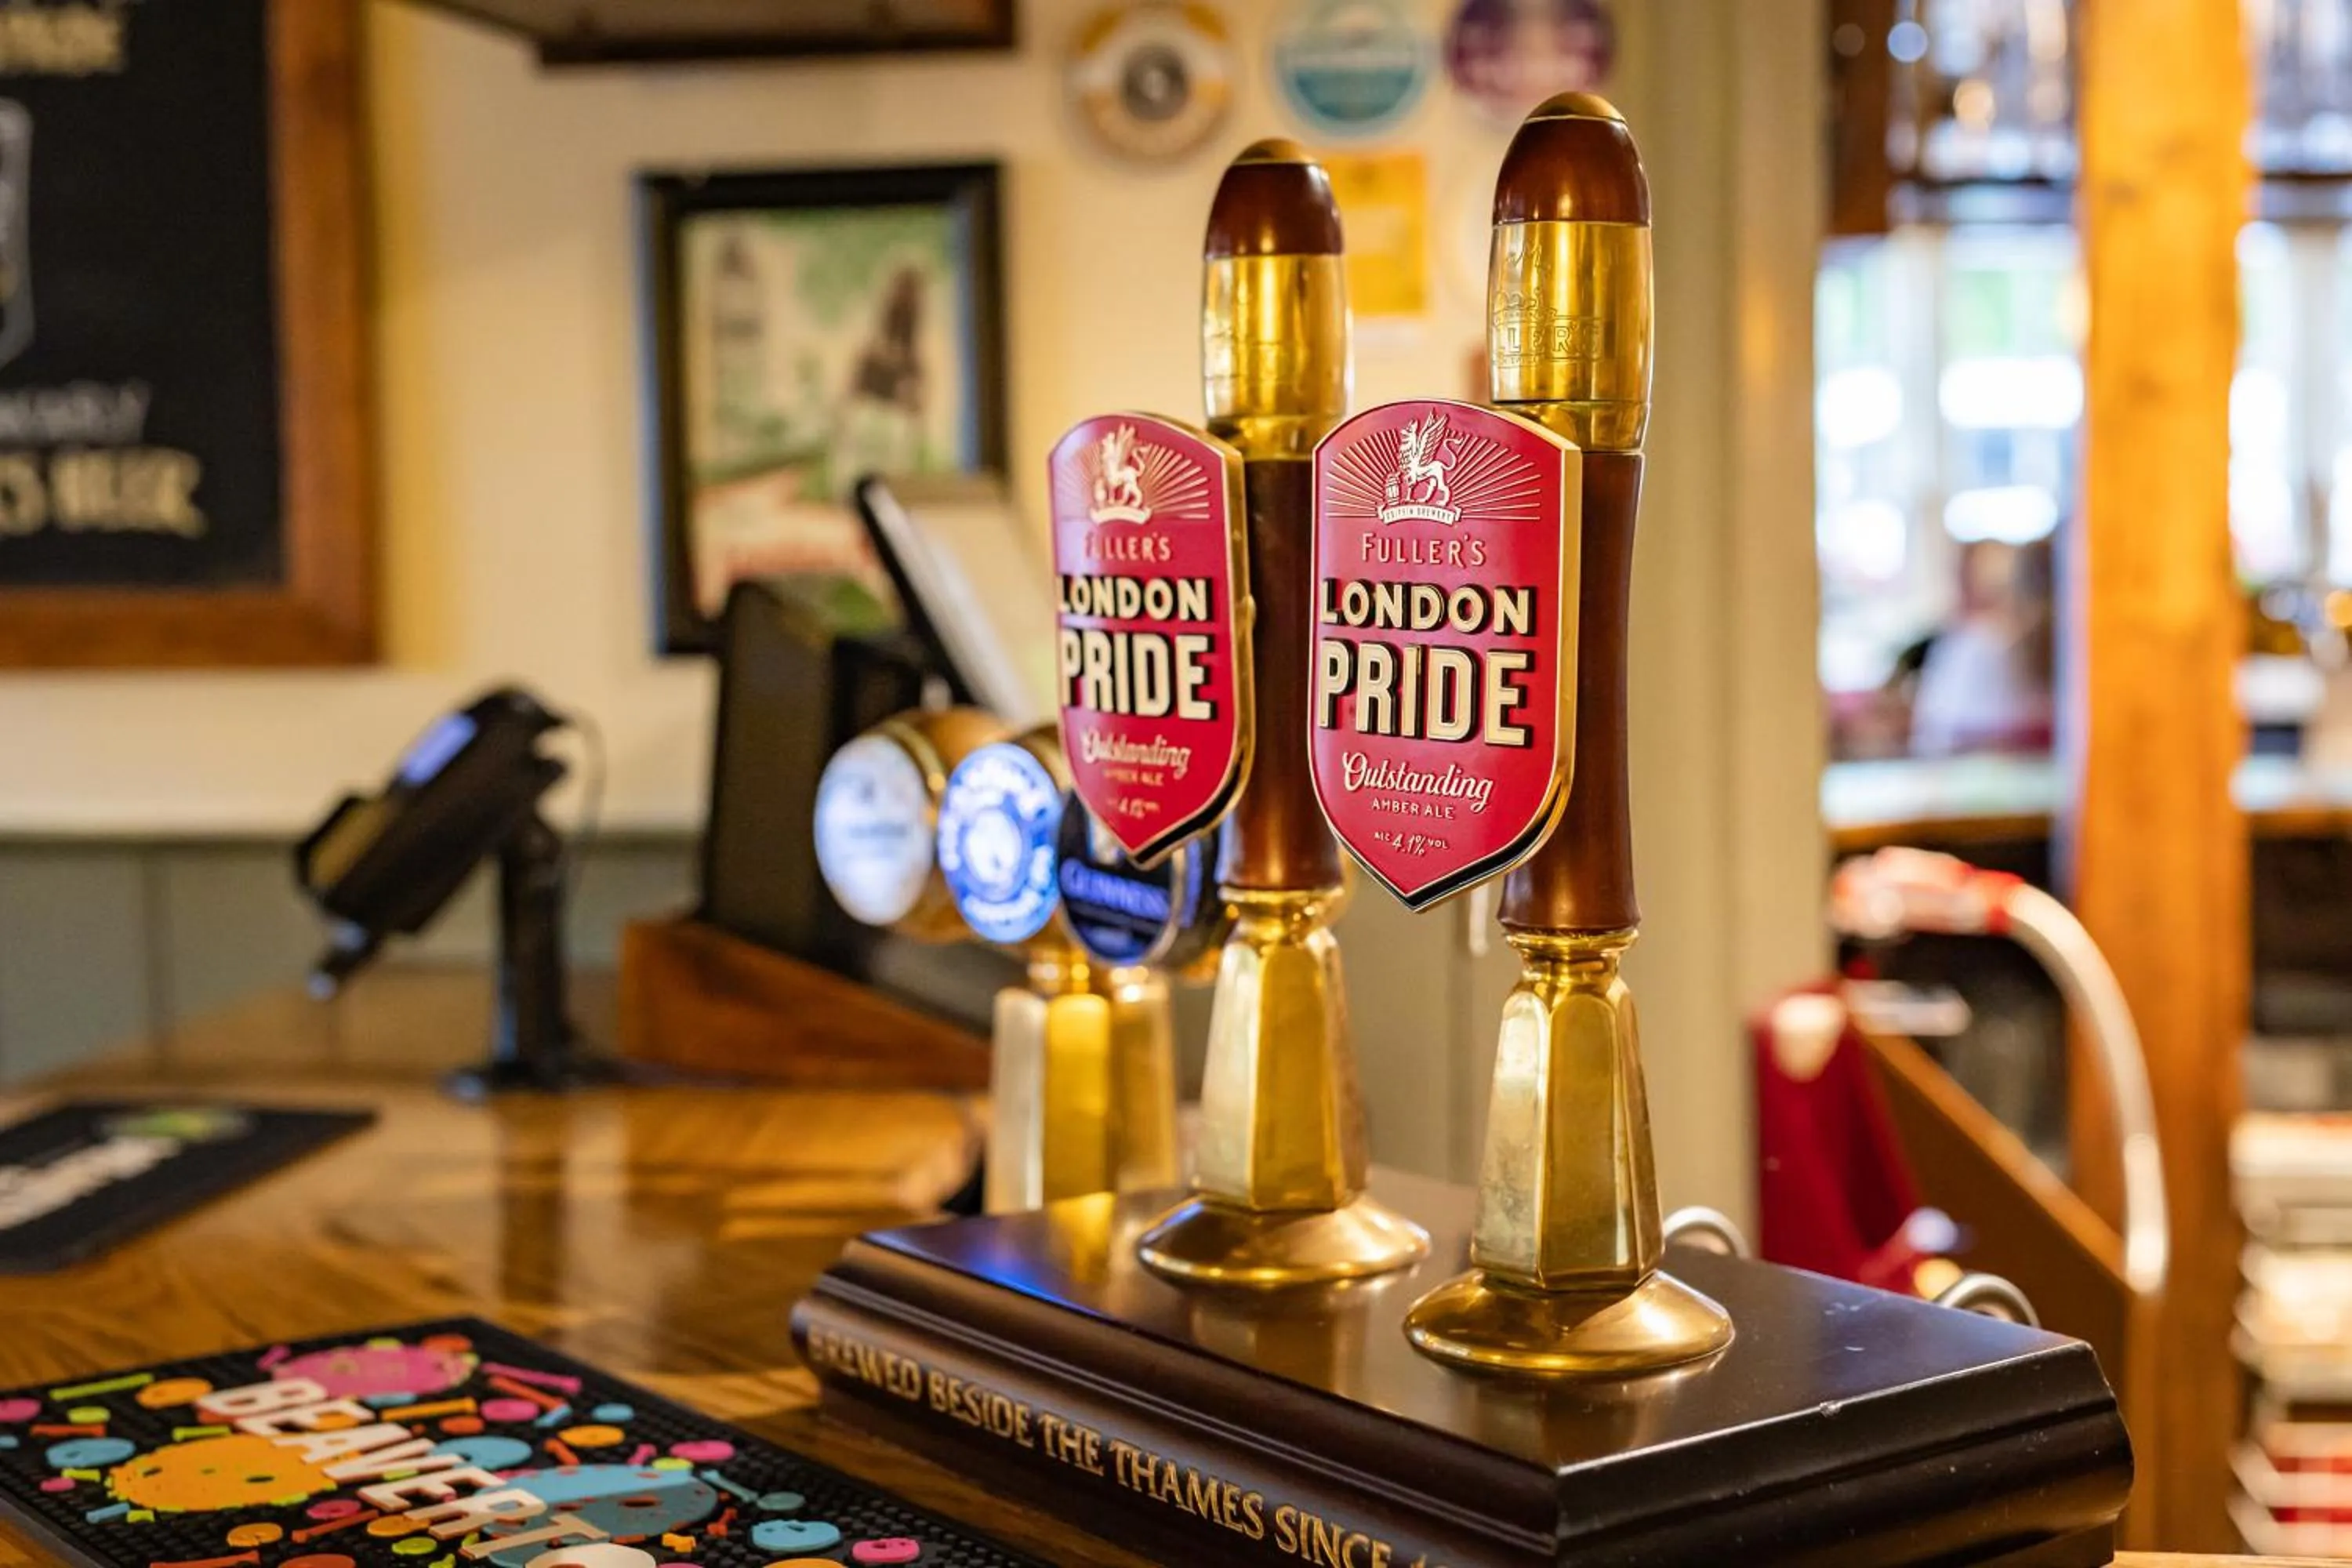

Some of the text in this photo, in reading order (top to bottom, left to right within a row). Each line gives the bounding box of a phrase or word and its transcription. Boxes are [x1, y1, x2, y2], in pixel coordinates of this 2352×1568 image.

[1361, 532, 1487, 568] FULLER'S
[1058, 574, 1213, 622] LONDON
[1320, 578, 1537, 636] LONDON
[1060, 628, 1218, 721] PRIDE
[1318, 638, 1534, 747] PRIDE
[1080, 728, 1192, 780] Outstanding
[1341, 752, 1494, 814] Outstanding
[1372, 797, 1456, 820] AMBER ALE
[1427, 837, 1449, 850] VOL
[808, 1325, 1393, 1568] BREWED BESIDE THE THAMES SINCE
